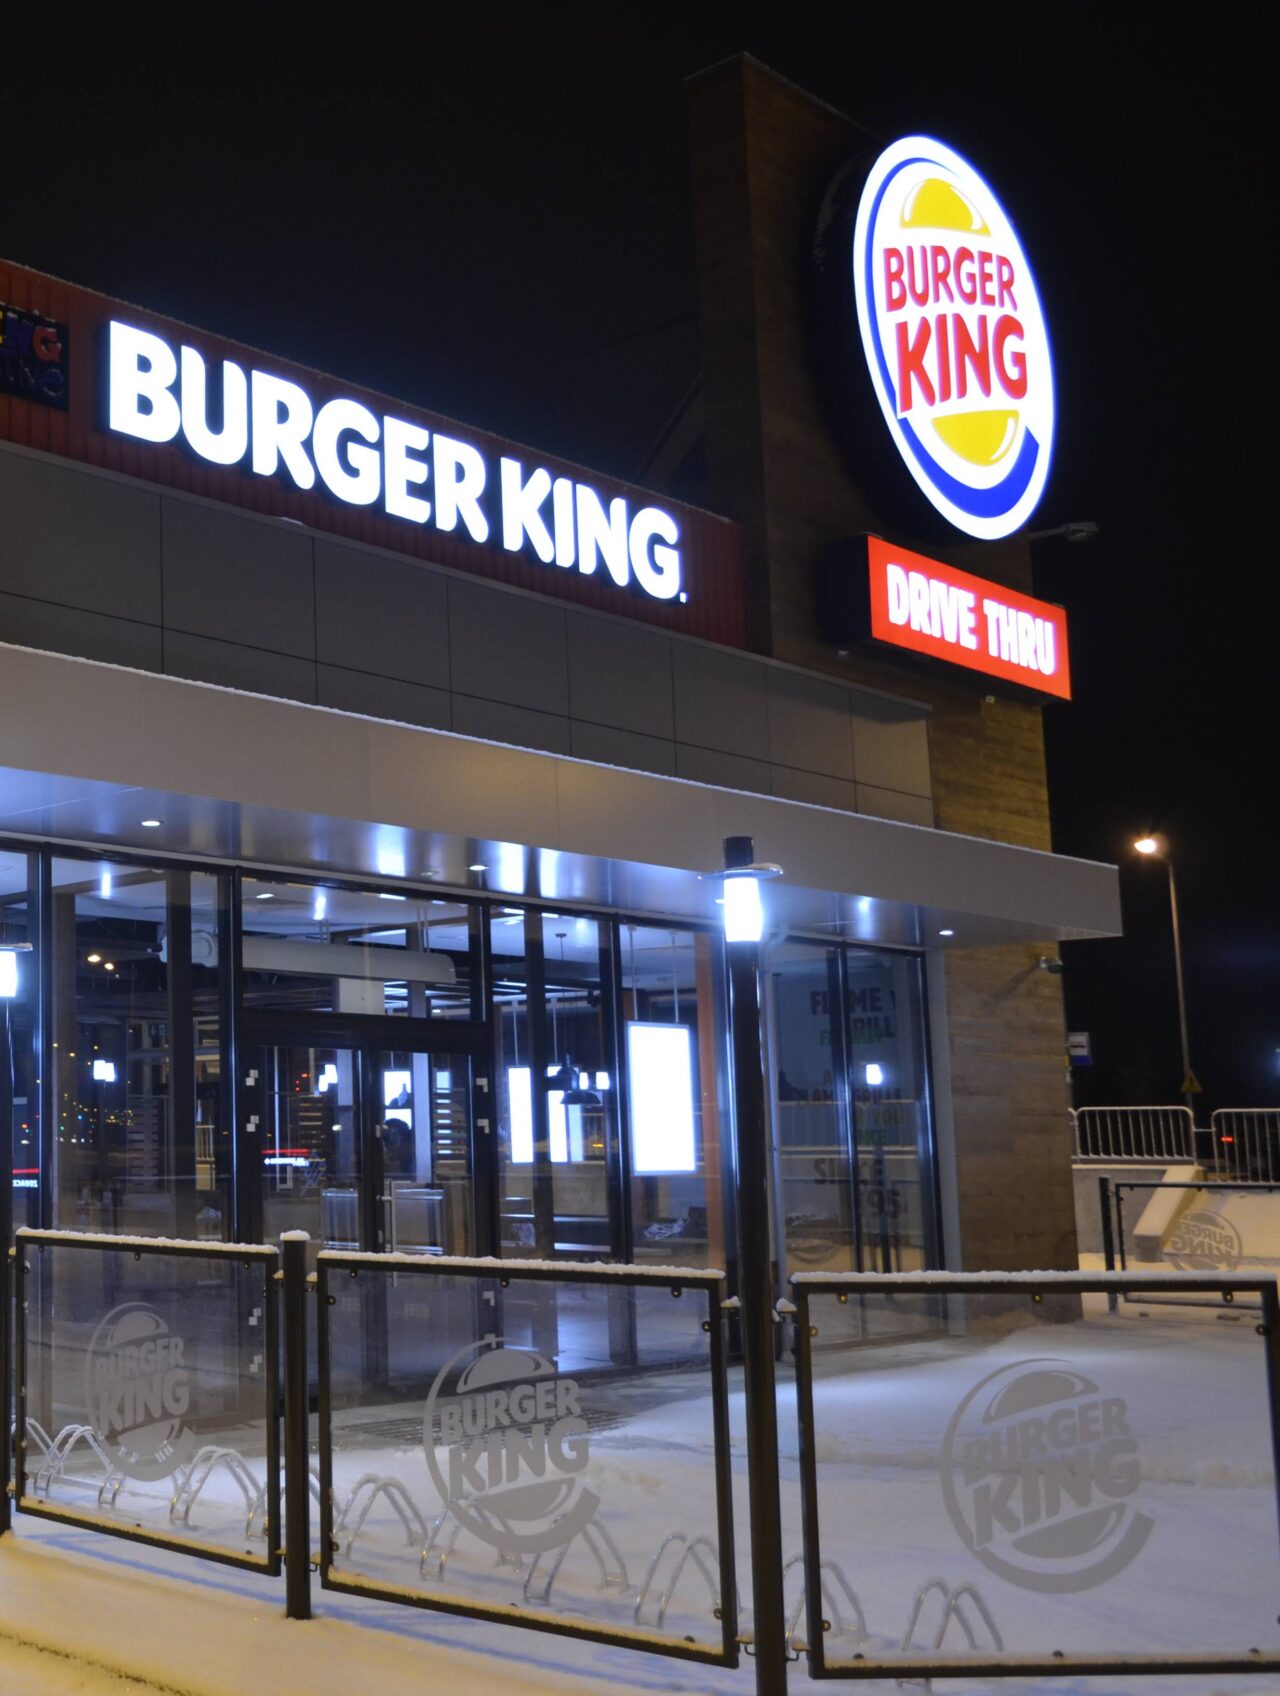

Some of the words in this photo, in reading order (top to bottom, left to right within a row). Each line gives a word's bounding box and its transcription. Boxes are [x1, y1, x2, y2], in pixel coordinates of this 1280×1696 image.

[884, 245, 1018, 313] BURGER
[895, 313, 1028, 412] KING
[109, 320, 489, 544] BURGER
[500, 456, 680, 600] KING
[886, 563, 978, 650] DRIVE
[983, 598, 1057, 676] THRU
[809, 986, 882, 1016] FLME
[95, 1336, 185, 1390] BURGER
[99, 1367, 190, 1440] KING
[440, 1379, 582, 1446] BURGER
[963, 1397, 1130, 1487] BURGER
[448, 1417, 589, 1503] KING
[973, 1438, 1140, 1550] KING
